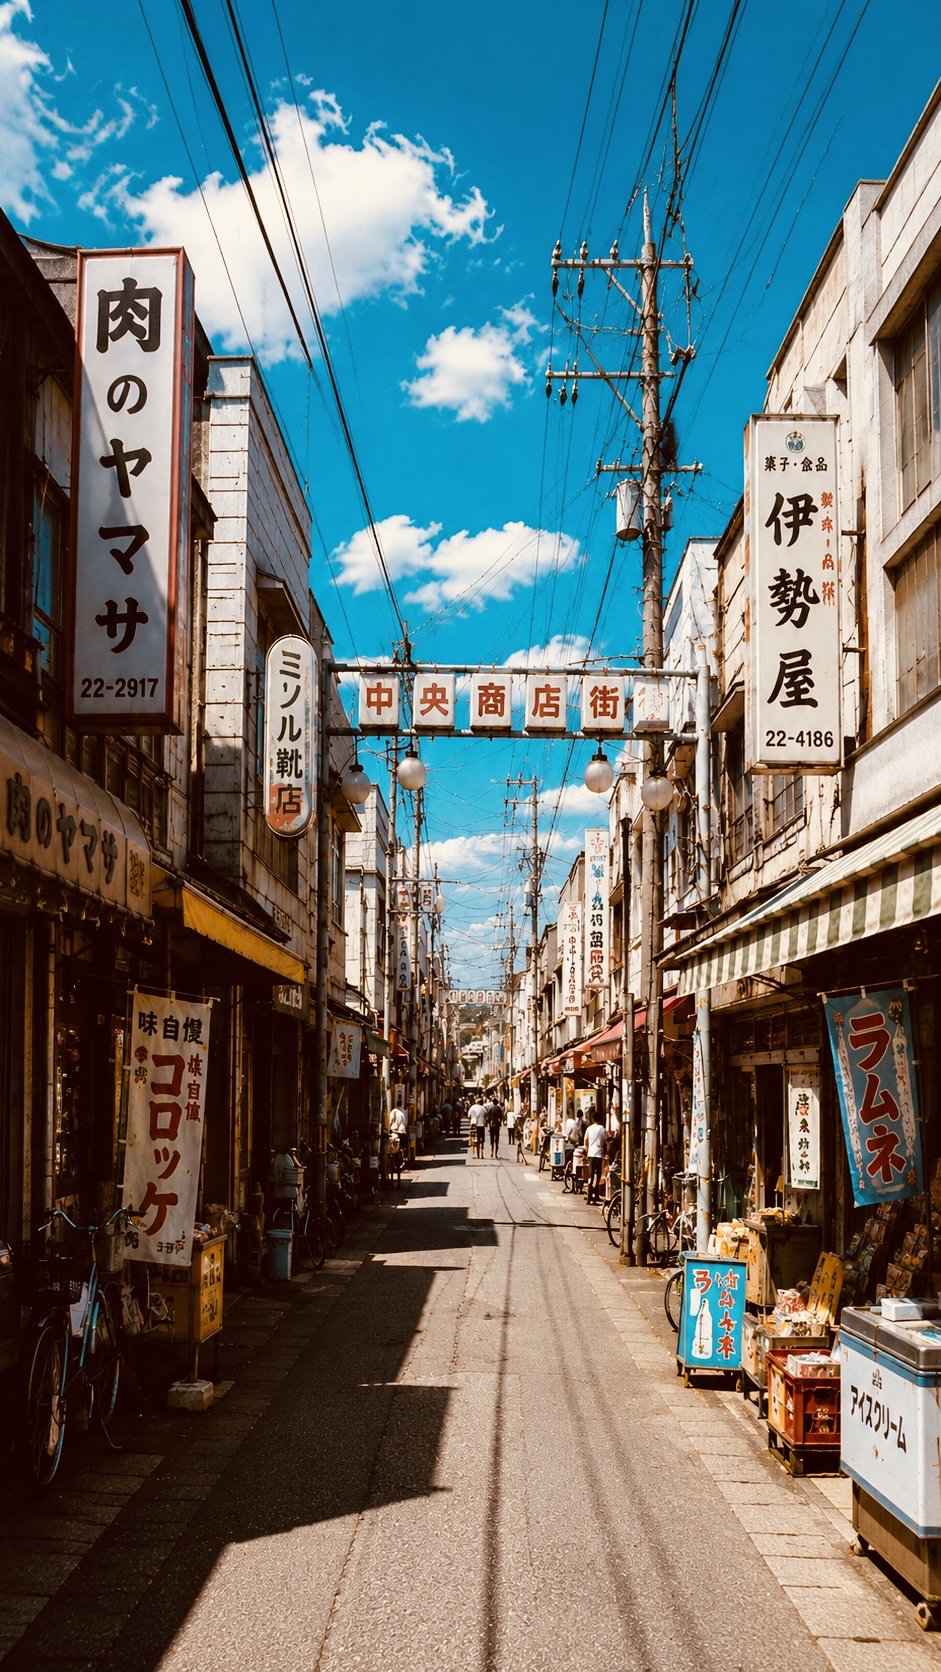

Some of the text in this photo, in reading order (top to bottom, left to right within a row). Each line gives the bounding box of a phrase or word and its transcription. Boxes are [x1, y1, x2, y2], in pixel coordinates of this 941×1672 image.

[95, 277, 163, 654] 肉のヤマサ
[765, 492, 821, 709] 伊勢屋
[80, 678, 159, 699] 22-2917
[366, 681, 620, 719] 中央商店街
[765, 730, 834, 748] 22-4186
[6, 772, 118, 885] 肉のヤマサ
[138, 1011, 203, 1045] 味自慢
[848, 1012, 906, 1183] ラムネ
[139, 1053, 186, 1236] コロッケ
[851, 1384, 907, 1453] アイスクリーム
